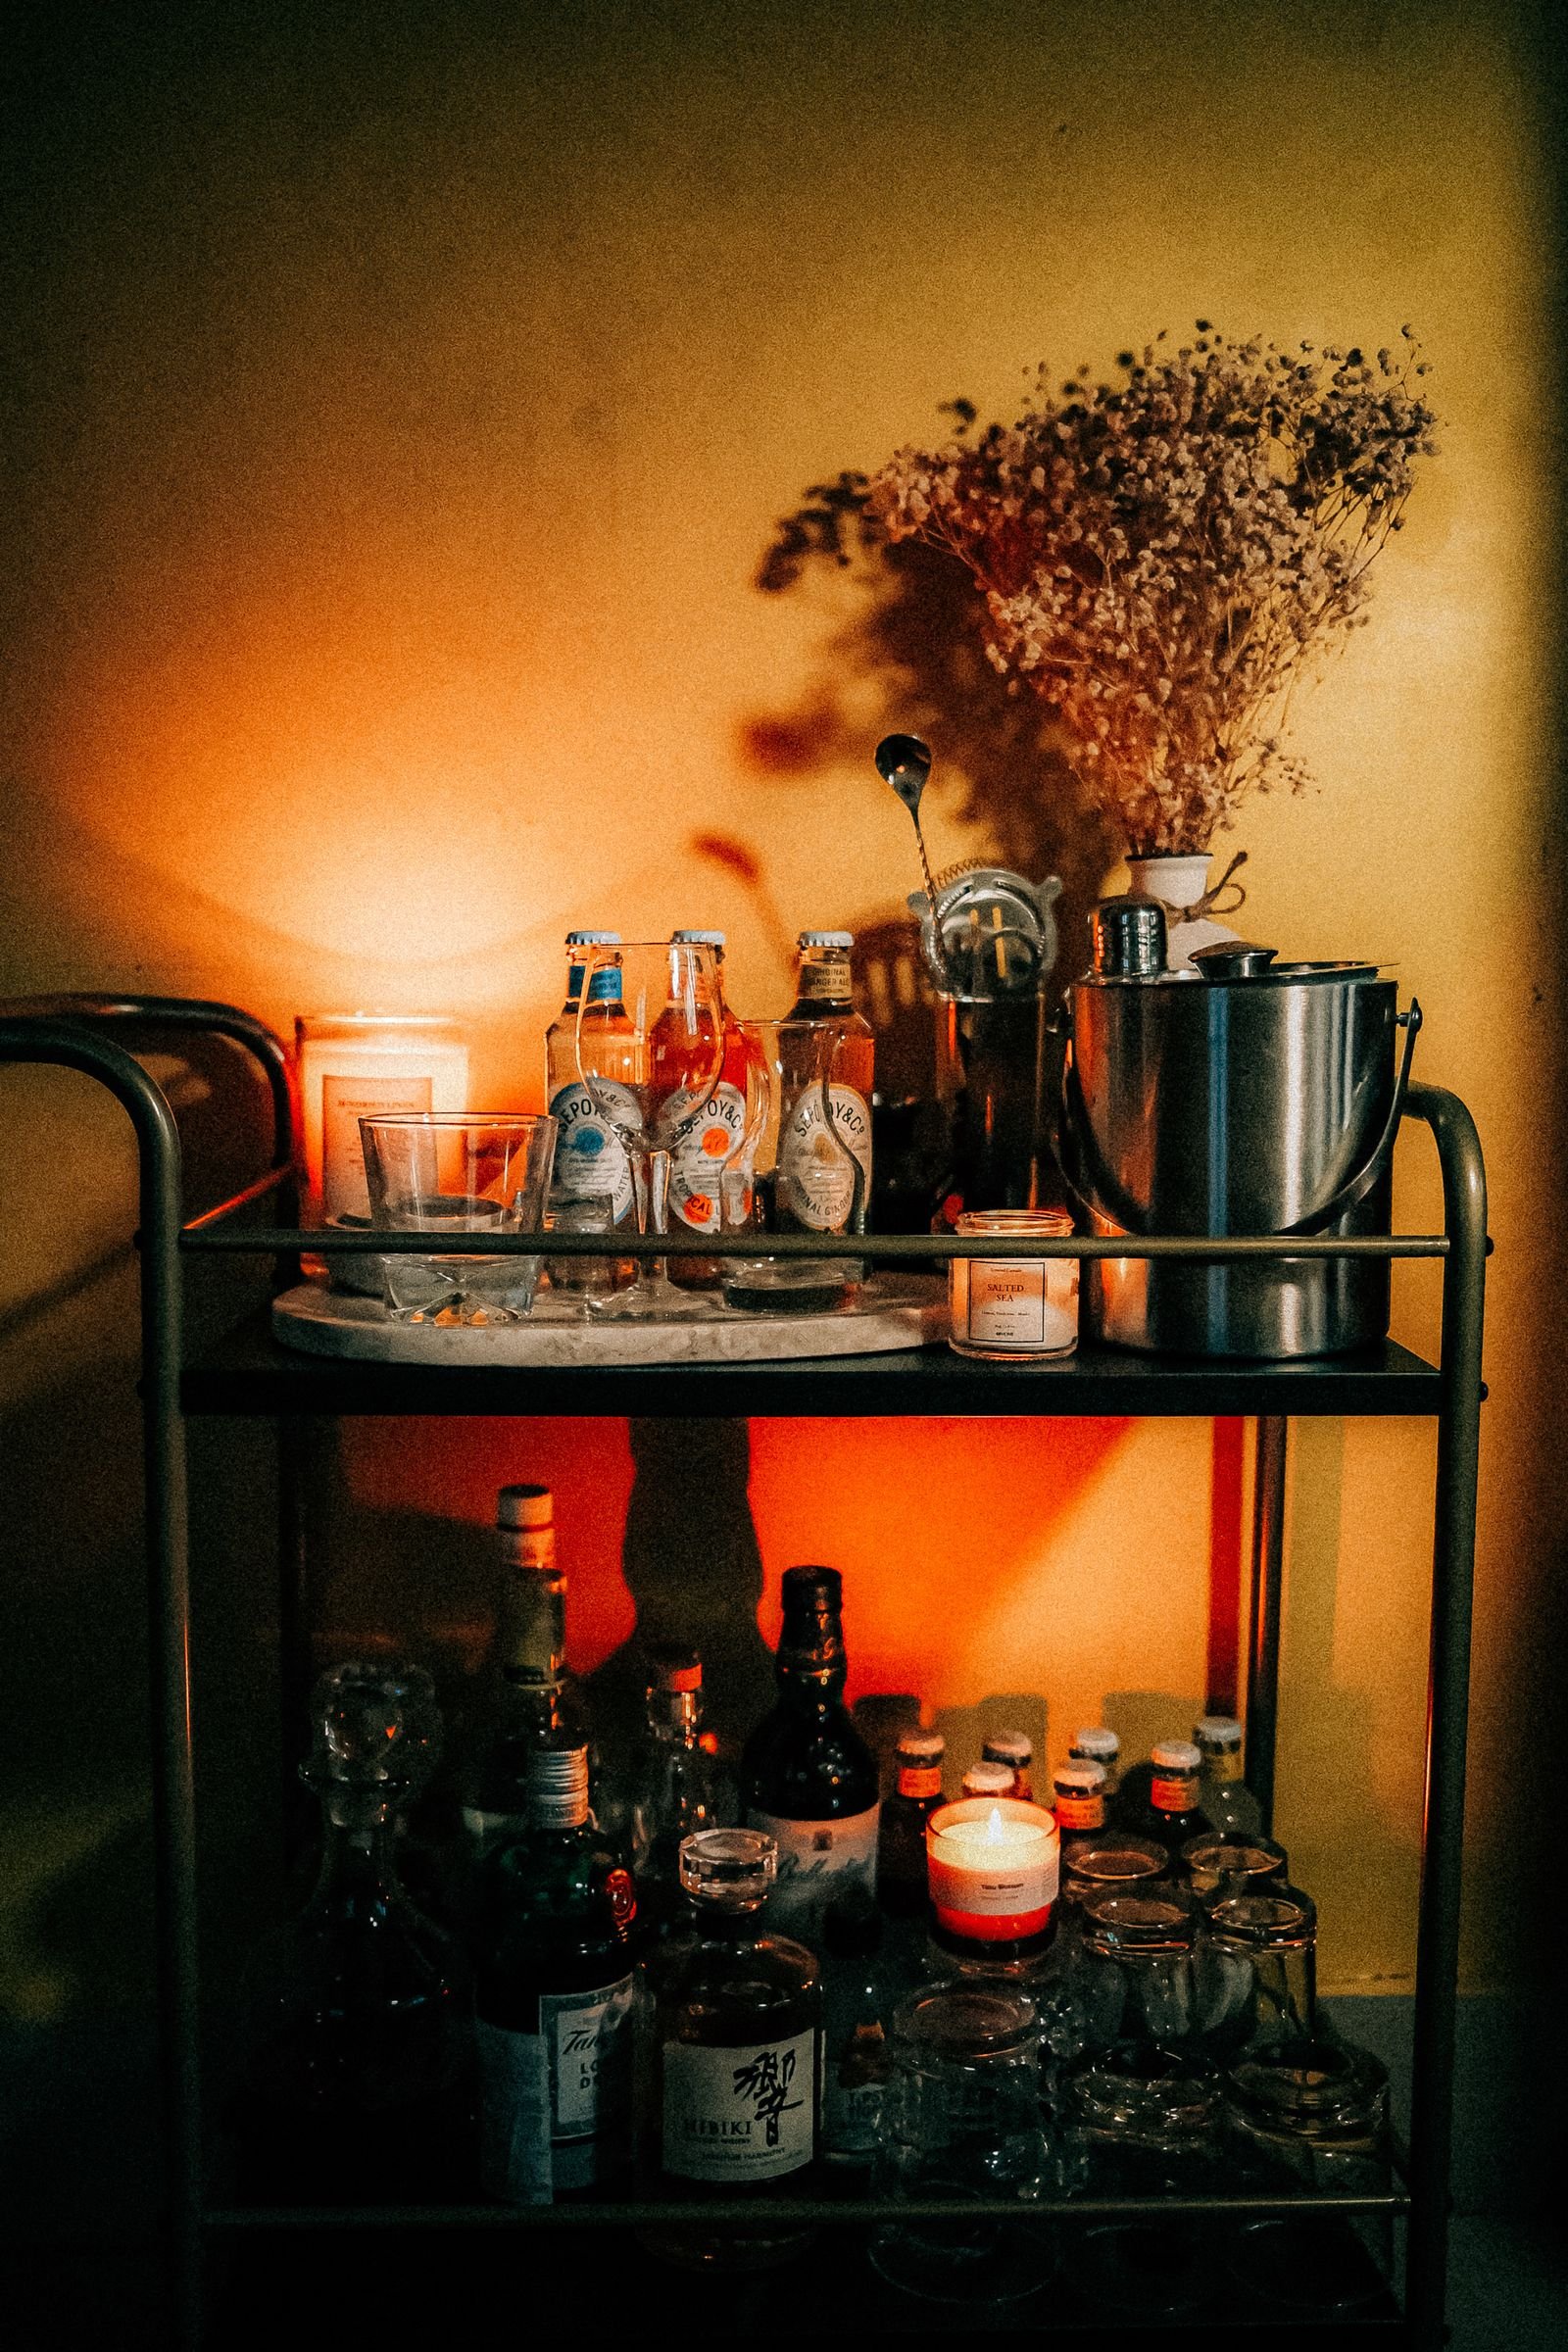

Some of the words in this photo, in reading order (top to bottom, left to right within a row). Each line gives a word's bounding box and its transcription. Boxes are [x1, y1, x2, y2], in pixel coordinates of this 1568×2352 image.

[613, 1166, 630, 1202] WATER
[987, 1283, 1024, 1293] SALTED
[996, 1294, 1014, 1302] SEA
[684, 2118, 753, 2135] HIBIKI
